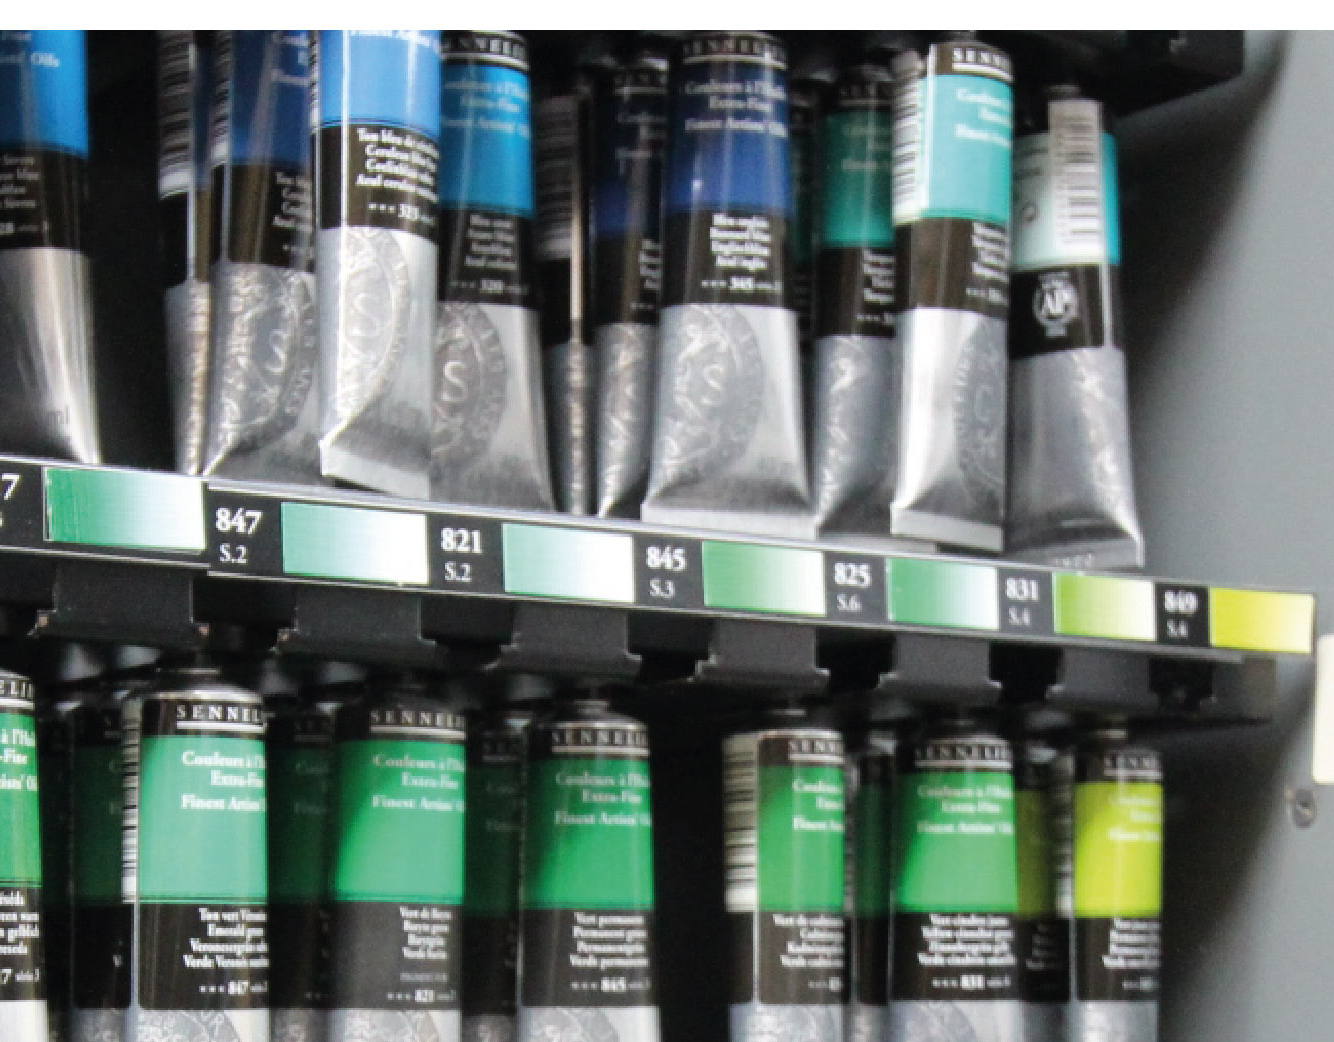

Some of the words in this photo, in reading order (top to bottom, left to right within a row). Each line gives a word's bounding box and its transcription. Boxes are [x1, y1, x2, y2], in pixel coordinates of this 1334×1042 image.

[215, 508, 261, 534] 847
[440, 528, 482, 554] 821
[220, 543, 248, 564] S.2
[645, 547, 685, 571] 845
[444, 561, 472, 582] S.2
[834, 563, 870, 587] 825
[650, 579, 675, 598] S.3
